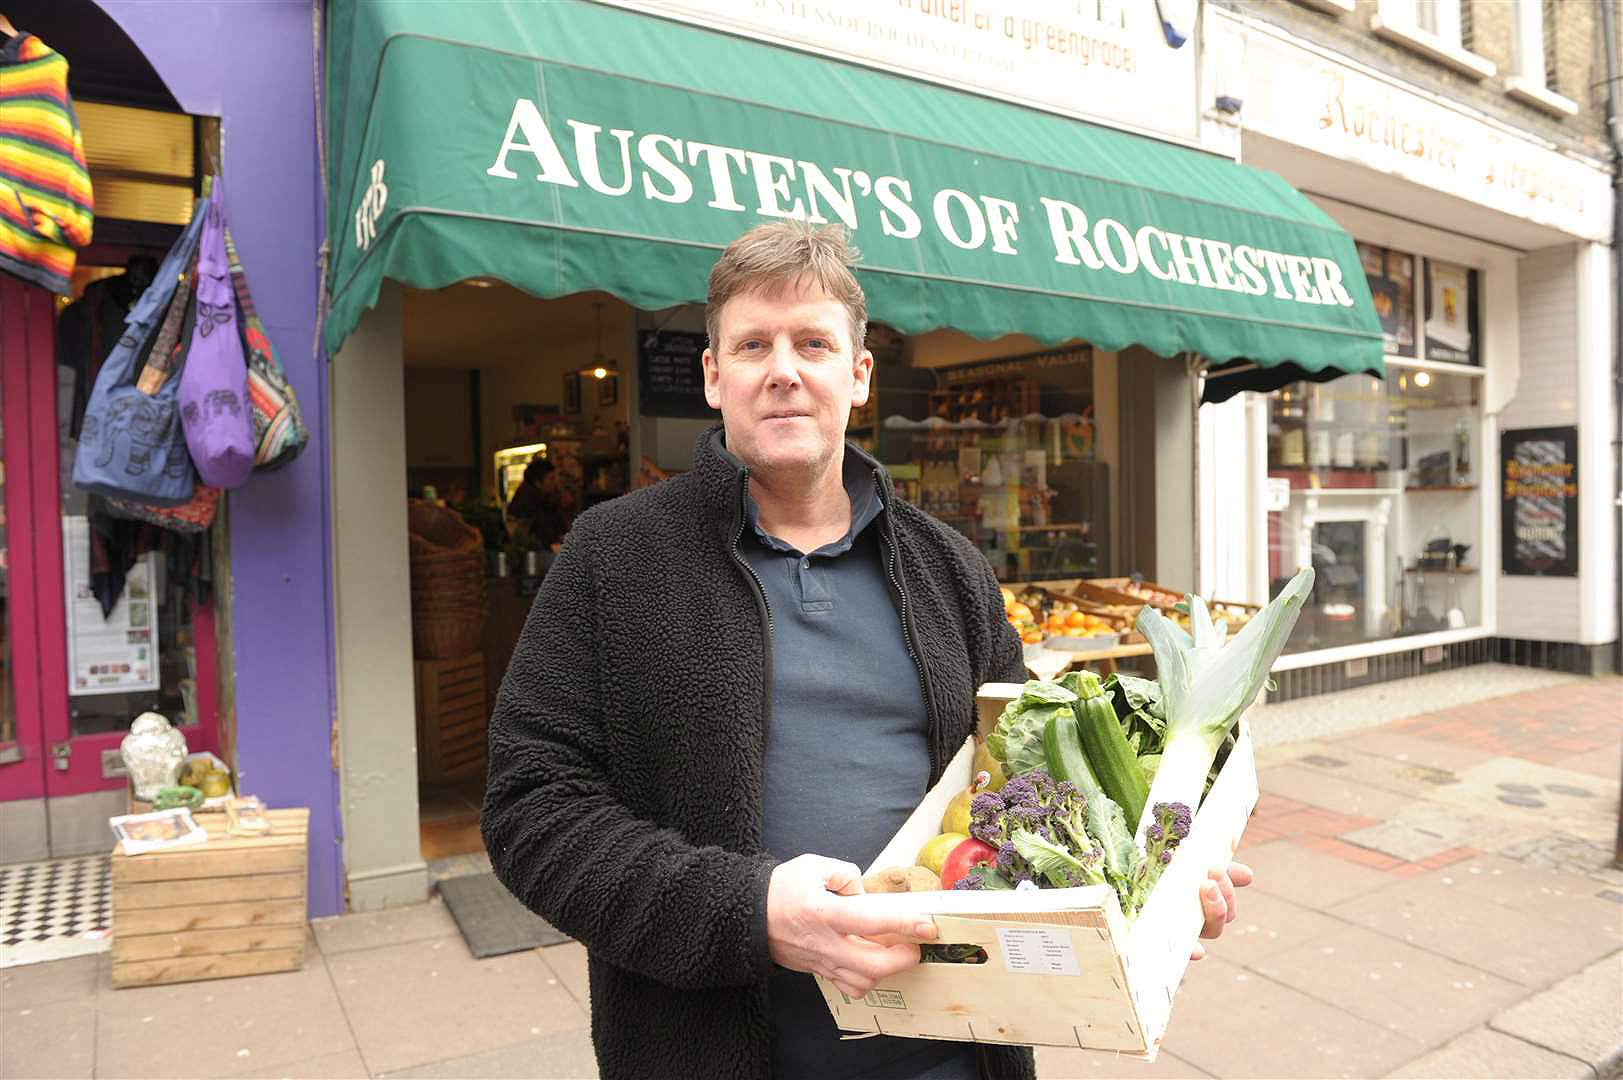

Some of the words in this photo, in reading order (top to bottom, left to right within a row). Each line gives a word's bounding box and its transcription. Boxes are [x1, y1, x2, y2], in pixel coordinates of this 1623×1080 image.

[487, 98, 922, 240] AUSTEN'S
[933, 188, 1020, 256] OF
[1040, 196, 1354, 307] ROCHESTER
